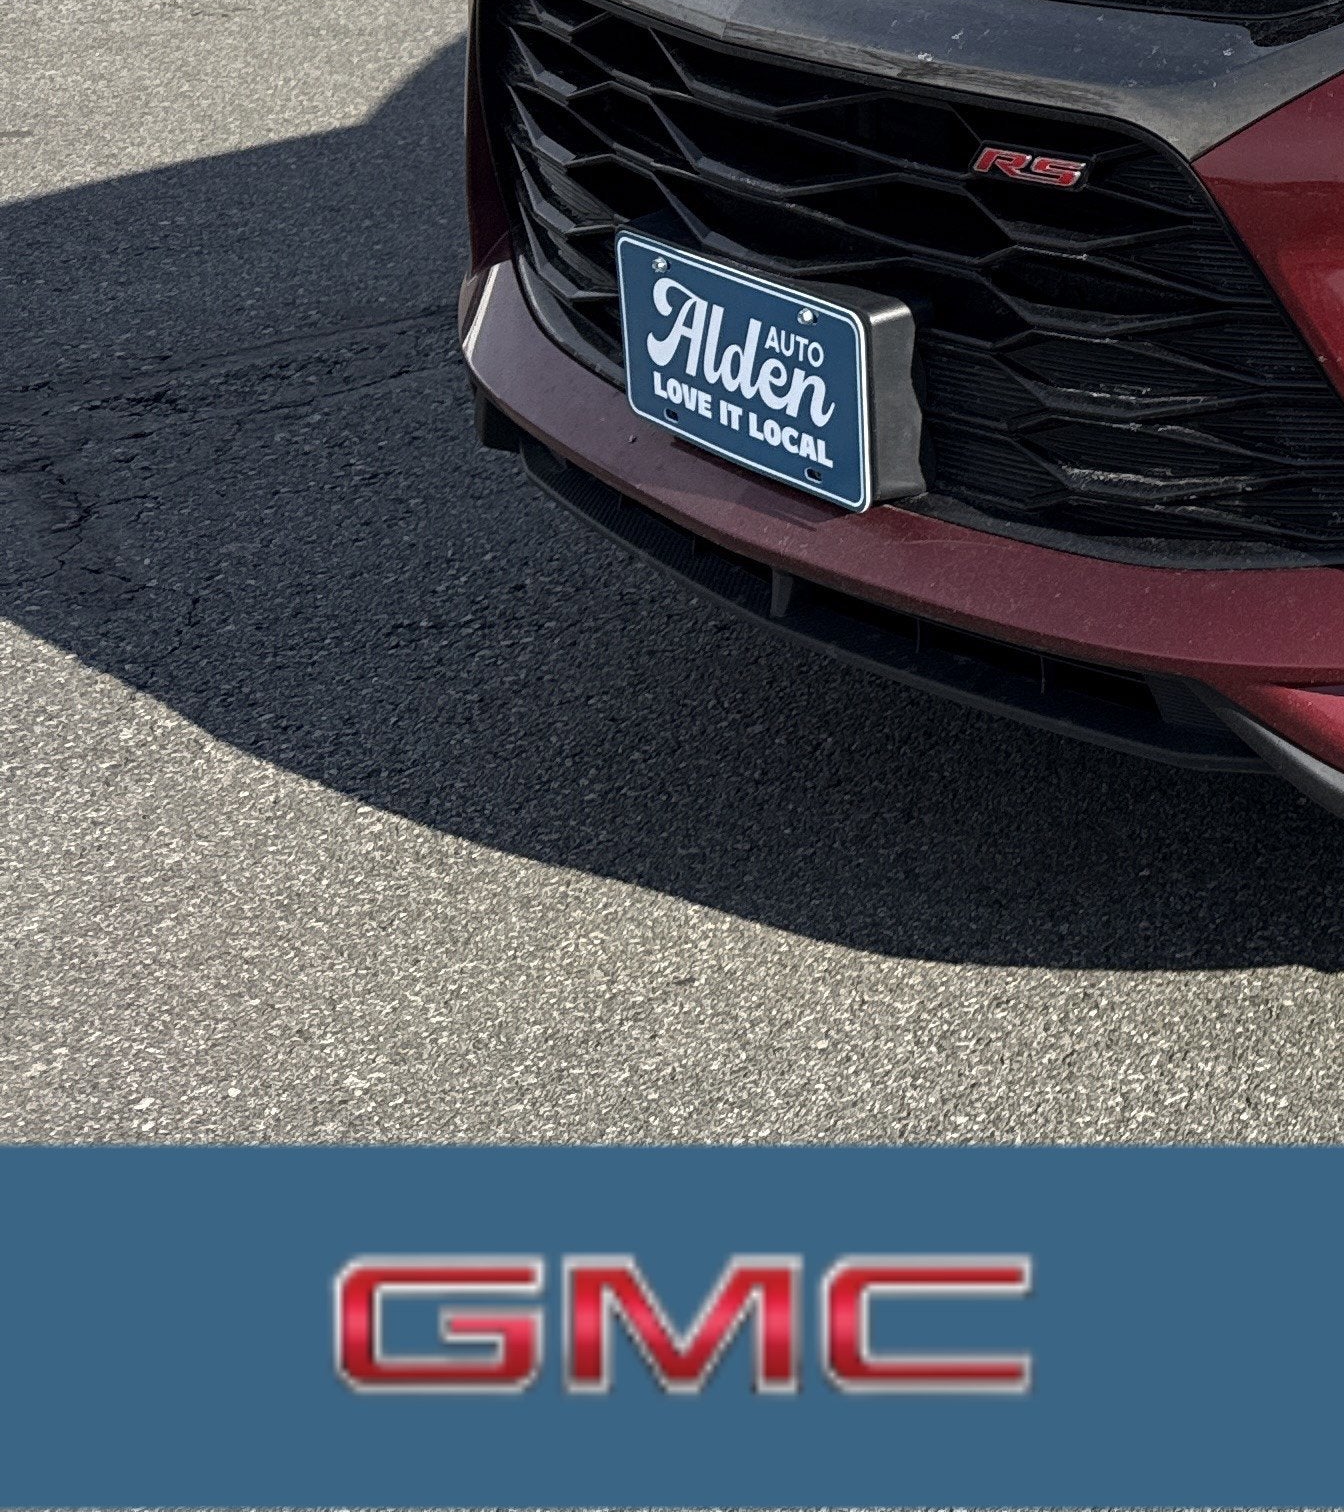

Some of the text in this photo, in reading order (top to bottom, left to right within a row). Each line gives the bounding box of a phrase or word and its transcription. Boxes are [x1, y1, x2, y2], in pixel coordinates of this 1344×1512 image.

[973, 147, 1087, 187] RS
[647, 277, 836, 428] Alden AUTO
[652, 371, 834, 469] LOVE IT LOCAL
